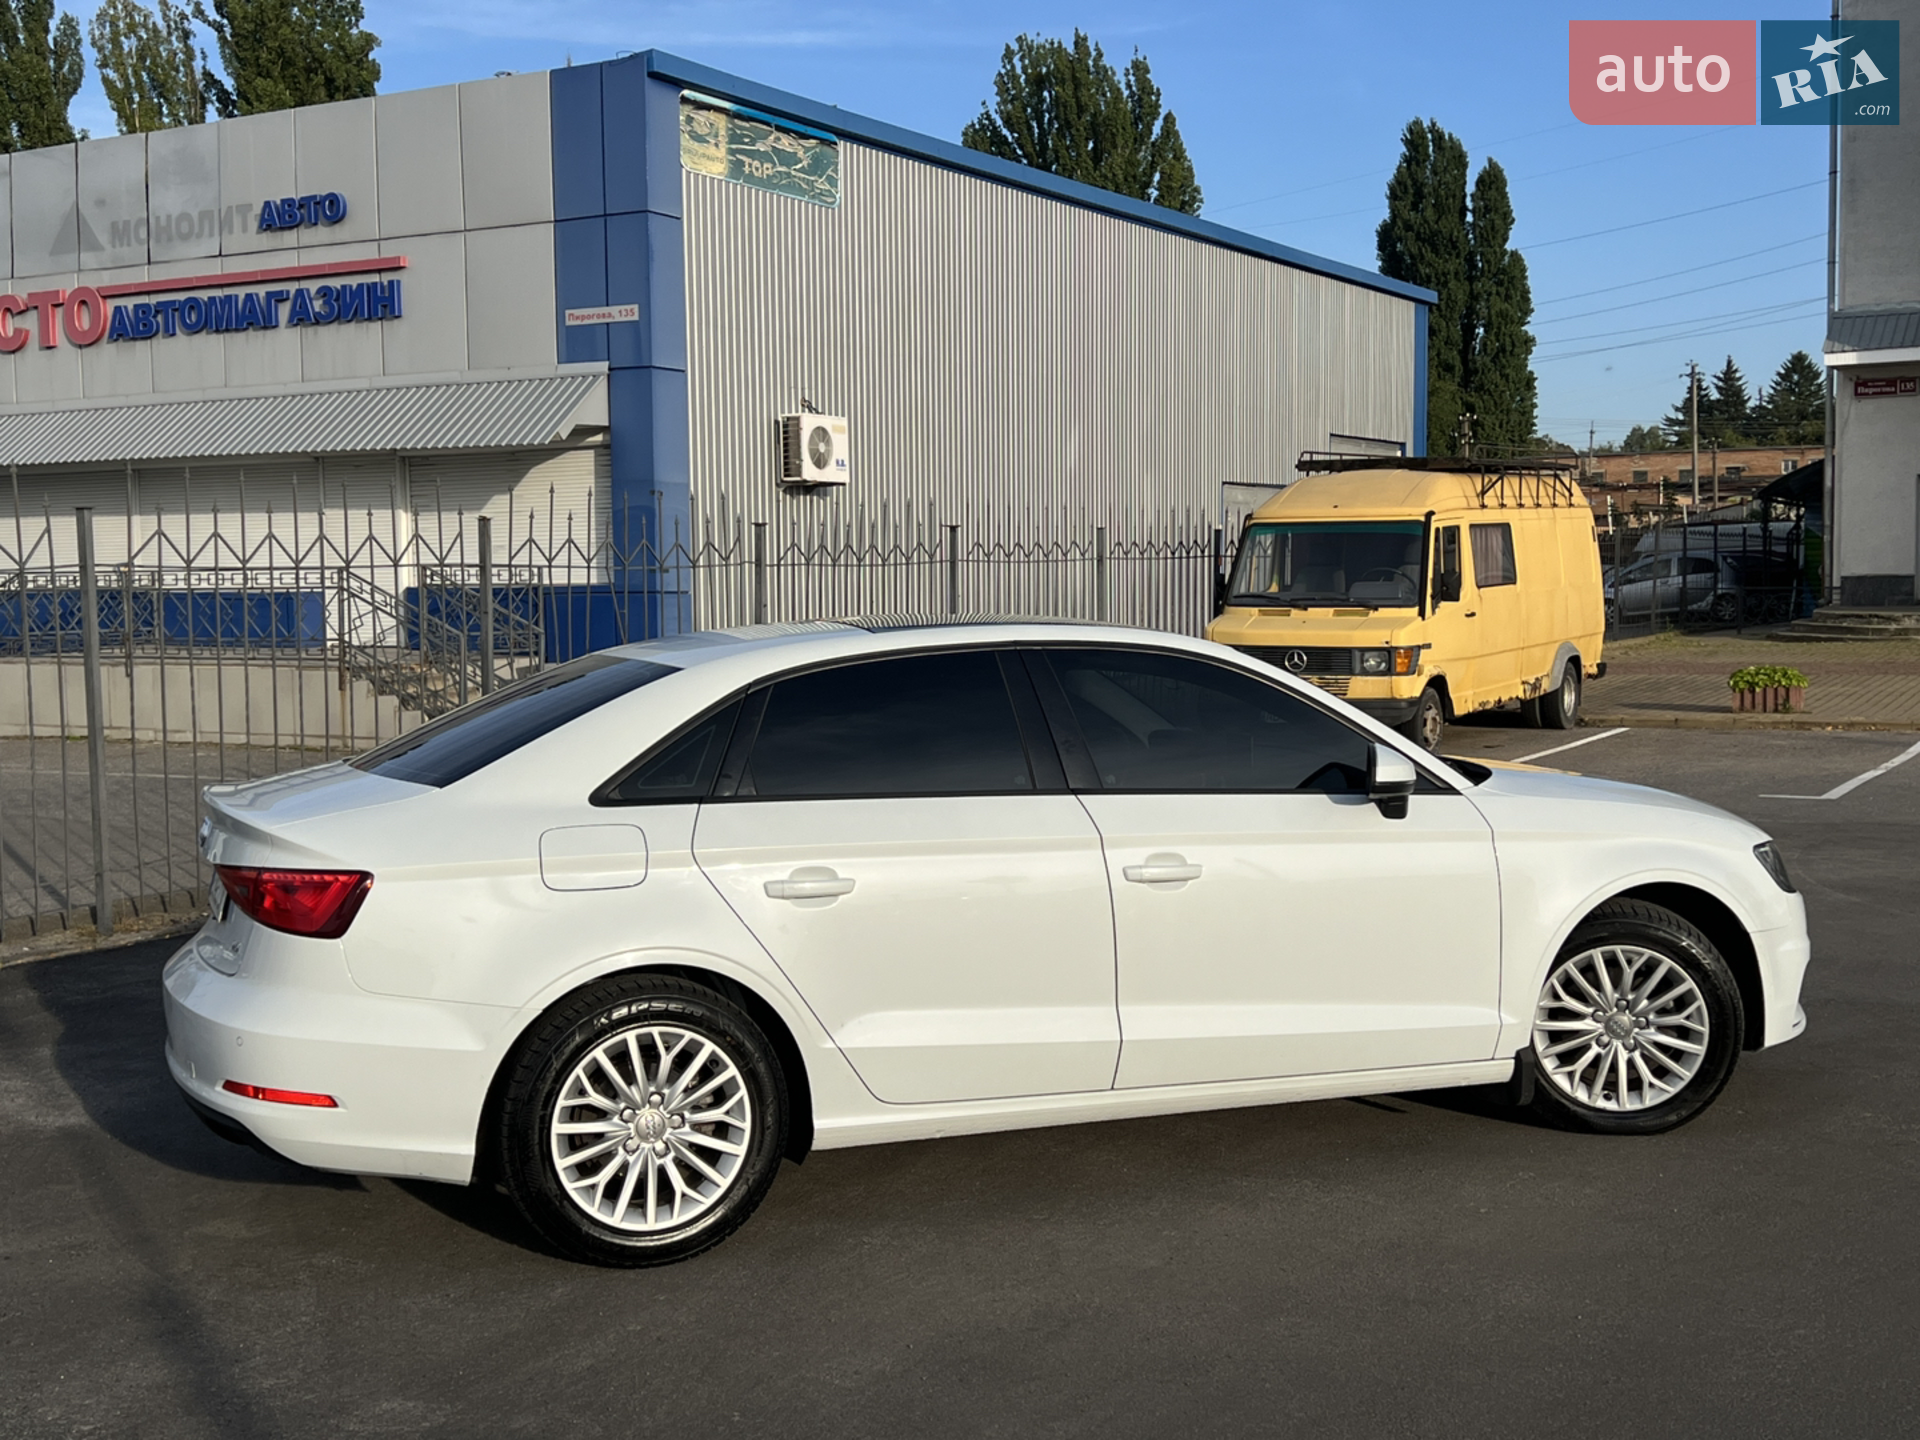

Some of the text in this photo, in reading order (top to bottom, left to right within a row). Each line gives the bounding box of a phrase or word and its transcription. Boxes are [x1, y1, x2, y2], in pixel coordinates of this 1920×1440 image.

[258, 192, 347, 231] АВТО
[0, 285, 109, 352] СТО
[108, 279, 402, 342] АВТОМАГАЗИН
[618, 308, 636, 318] 135
